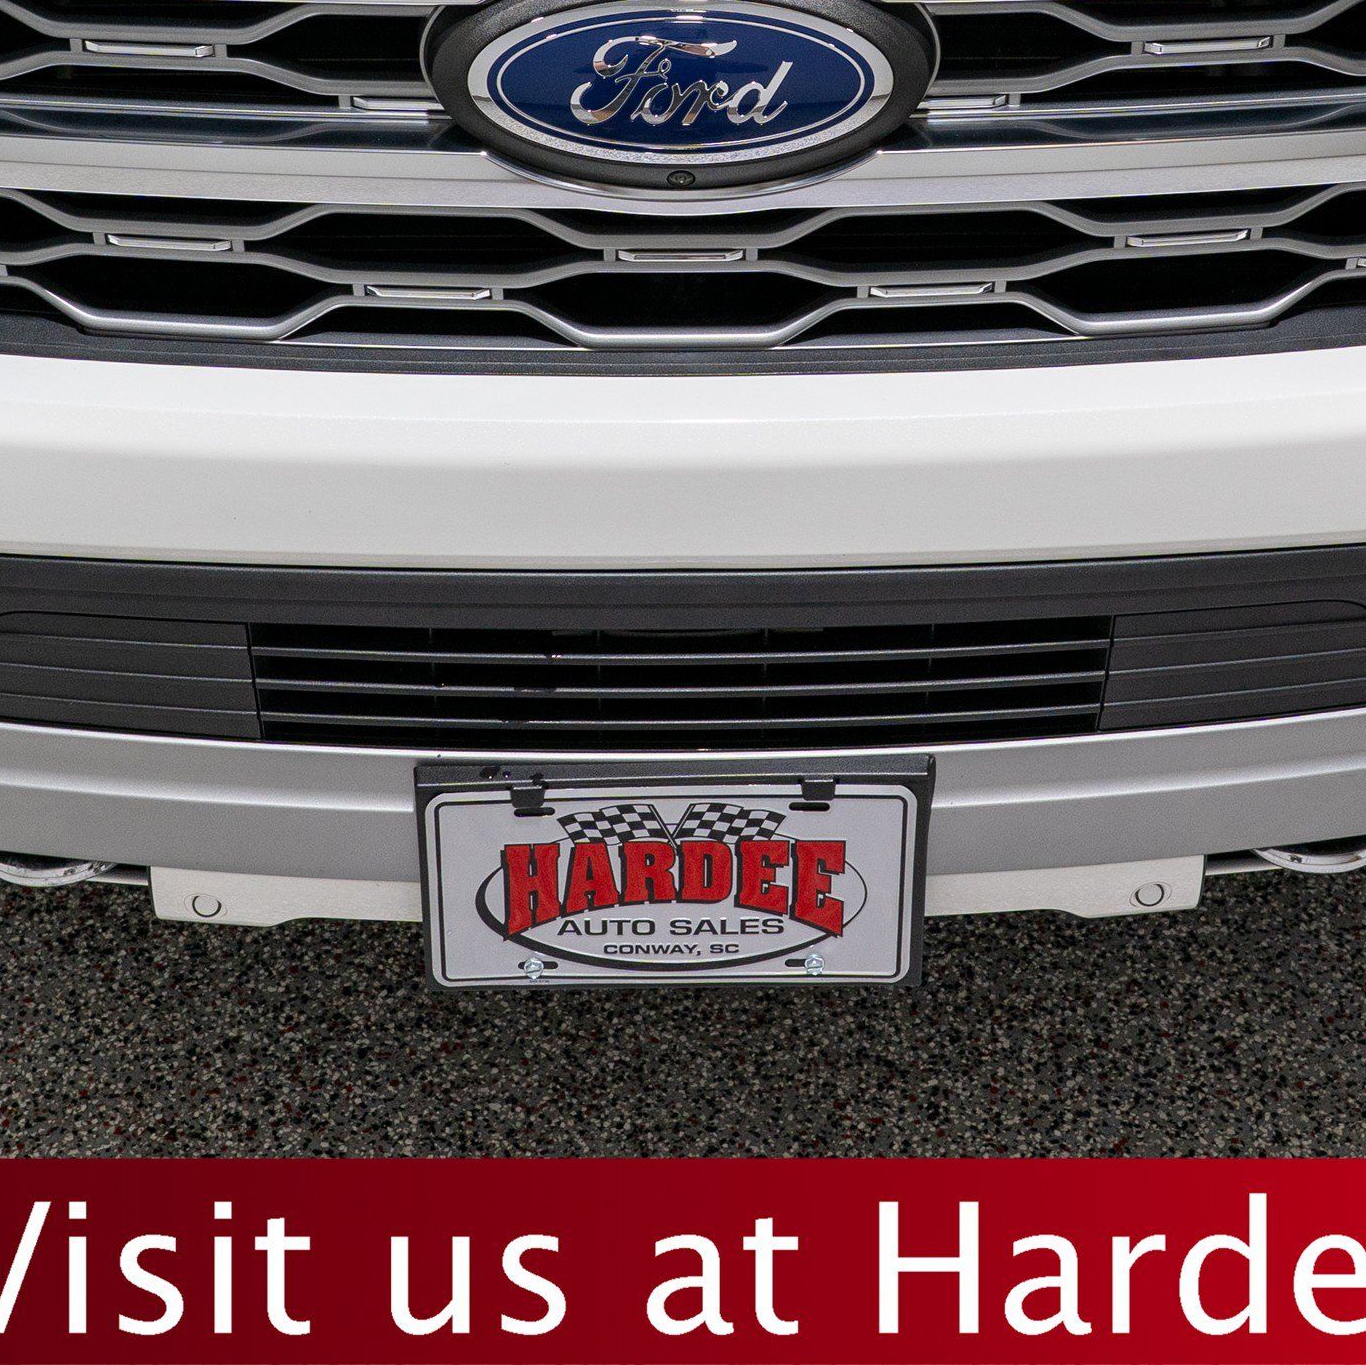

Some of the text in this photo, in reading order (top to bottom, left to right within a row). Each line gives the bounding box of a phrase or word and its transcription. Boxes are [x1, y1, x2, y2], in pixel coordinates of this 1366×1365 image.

[570, 35, 793, 126] Ford
[500, 839, 847, 939] HARDEE
[557, 918, 785, 936] AUTO SALES
[603, 943, 740, 956] CONWAY, SC
